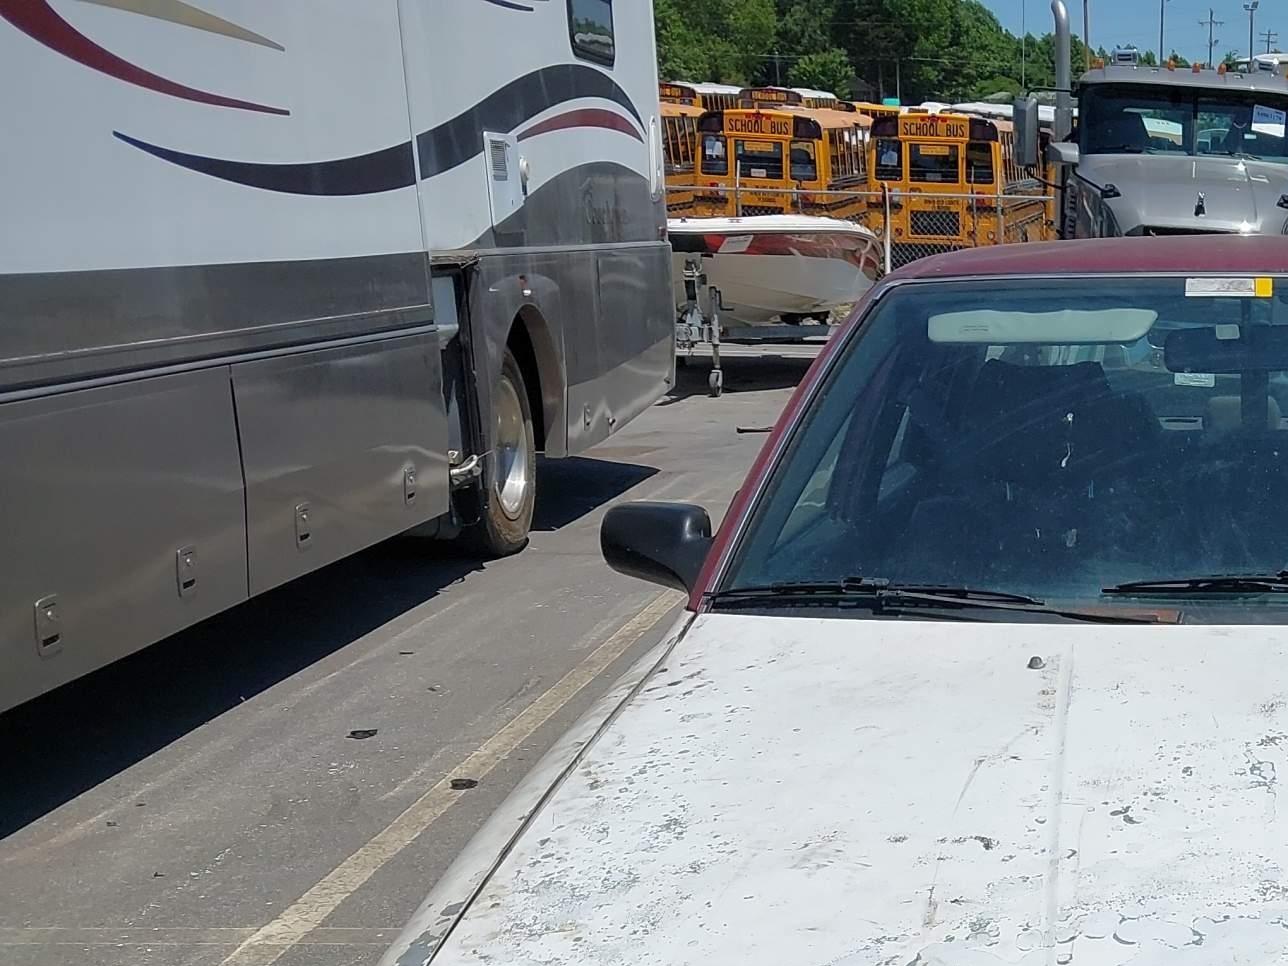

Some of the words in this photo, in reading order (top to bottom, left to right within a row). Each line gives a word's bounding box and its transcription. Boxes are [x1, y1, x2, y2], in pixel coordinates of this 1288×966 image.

[728, 118, 765, 134] SCHOOL
[771, 120, 789, 135] BUS
[903, 122, 941, 137] SCHOOL
[946, 123, 965, 137] BUS
